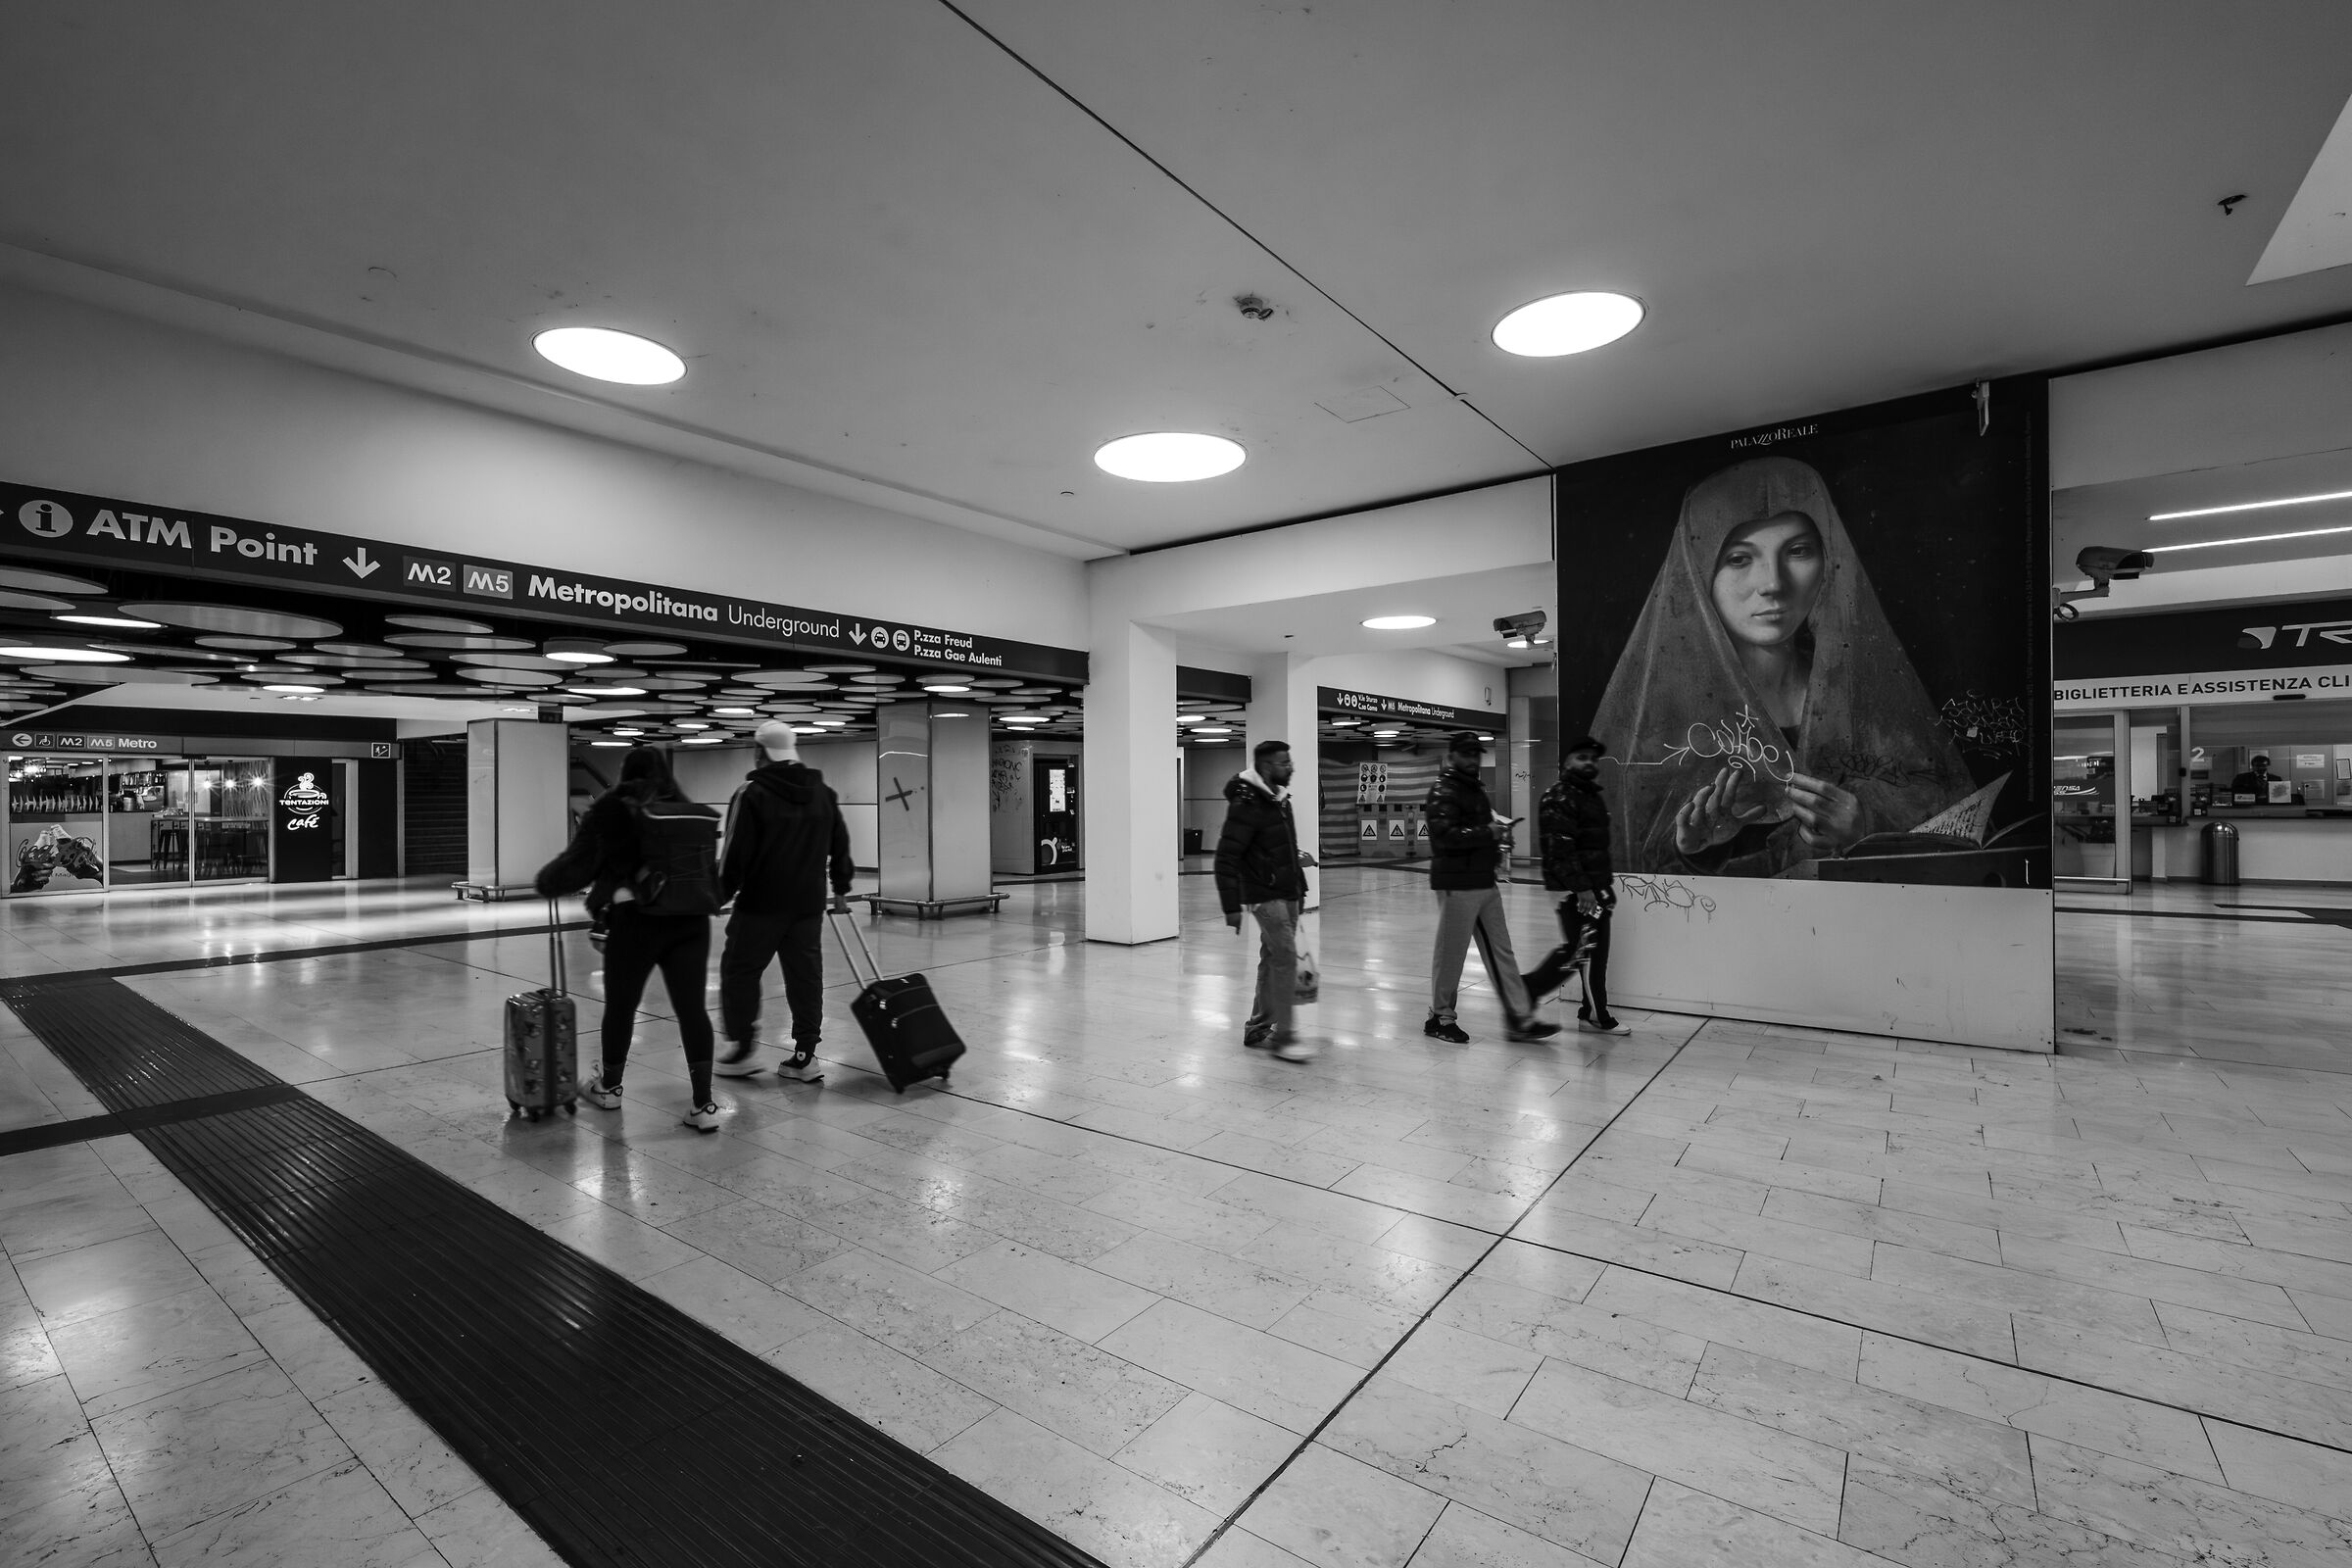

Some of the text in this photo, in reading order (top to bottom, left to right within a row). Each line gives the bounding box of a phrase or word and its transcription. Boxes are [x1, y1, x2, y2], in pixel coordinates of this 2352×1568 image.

[86, 509, 318, 565] ATM Point
[408, 563, 840, 637] M2 M5 Metropolitana Underground
[913, 629, 973, 648] P.zza Freud
[913, 645, 1002, 666] P.zza Gae Aulenti
[2054, 674, 2350, 701] BIGLIETTERIA E ASSISTENZA CLI
[1397, 702, 1431, 715] Metropolitana
[1431, 706, 1454, 719] Underground
[60, 737, 158, 749] M2 M5 Metro
[2191, 747, 2205, 762] 2
